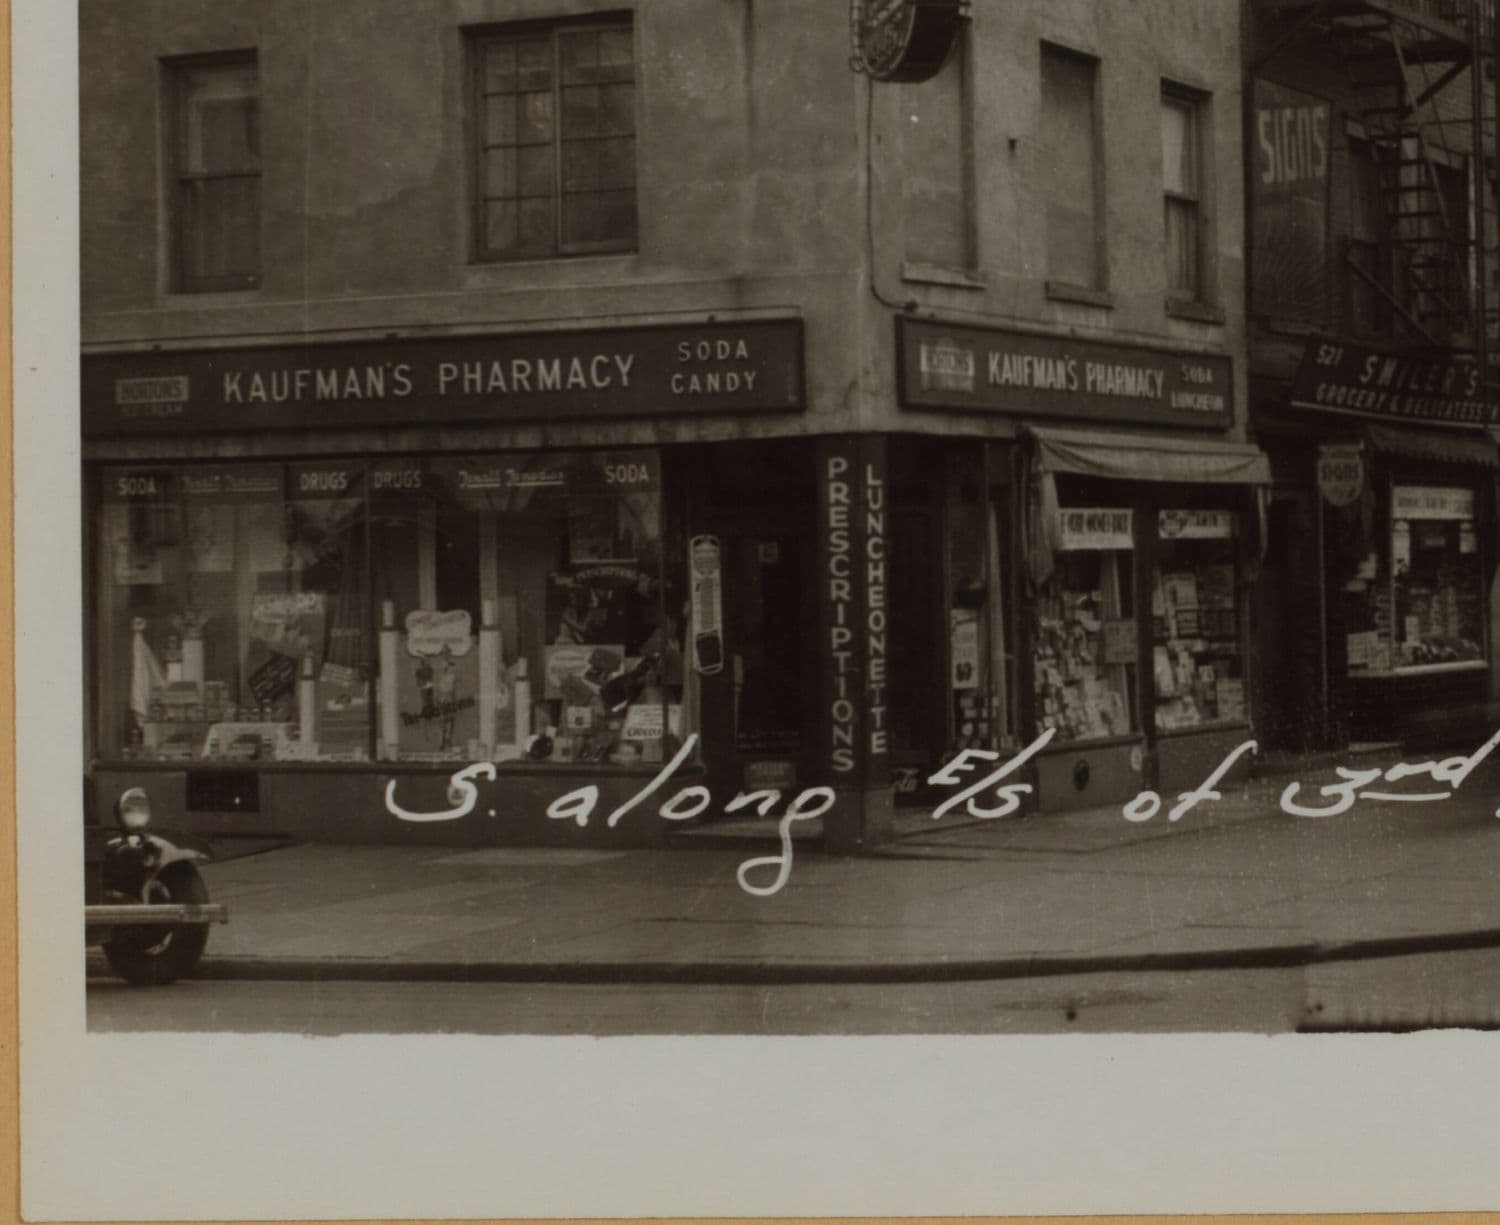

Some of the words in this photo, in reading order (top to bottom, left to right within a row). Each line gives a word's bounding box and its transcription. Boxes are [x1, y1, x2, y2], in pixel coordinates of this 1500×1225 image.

[676, 338, 750, 363] SODA
[222, 360, 414, 404] KAUFMAN'S
[438, 352, 636, 396] PHARMACY
[670, 369, 758, 395] CANDY
[988, 351, 1078, 392] KAUFMAN'S
[1085, 361, 1164, 400] PHARMACY
[1402, 395, 1500, 421] DELICATESSN
[116, 476, 158, 496] SODA
[299, 471, 348, 492] DRUGS
[372, 469, 423, 489] DRUGS
[604, 463, 650, 485] SODA
[826, 456, 856, 773] PRESCRIPTIONS
[866, 463, 889, 755] LUNCHEONETTE
